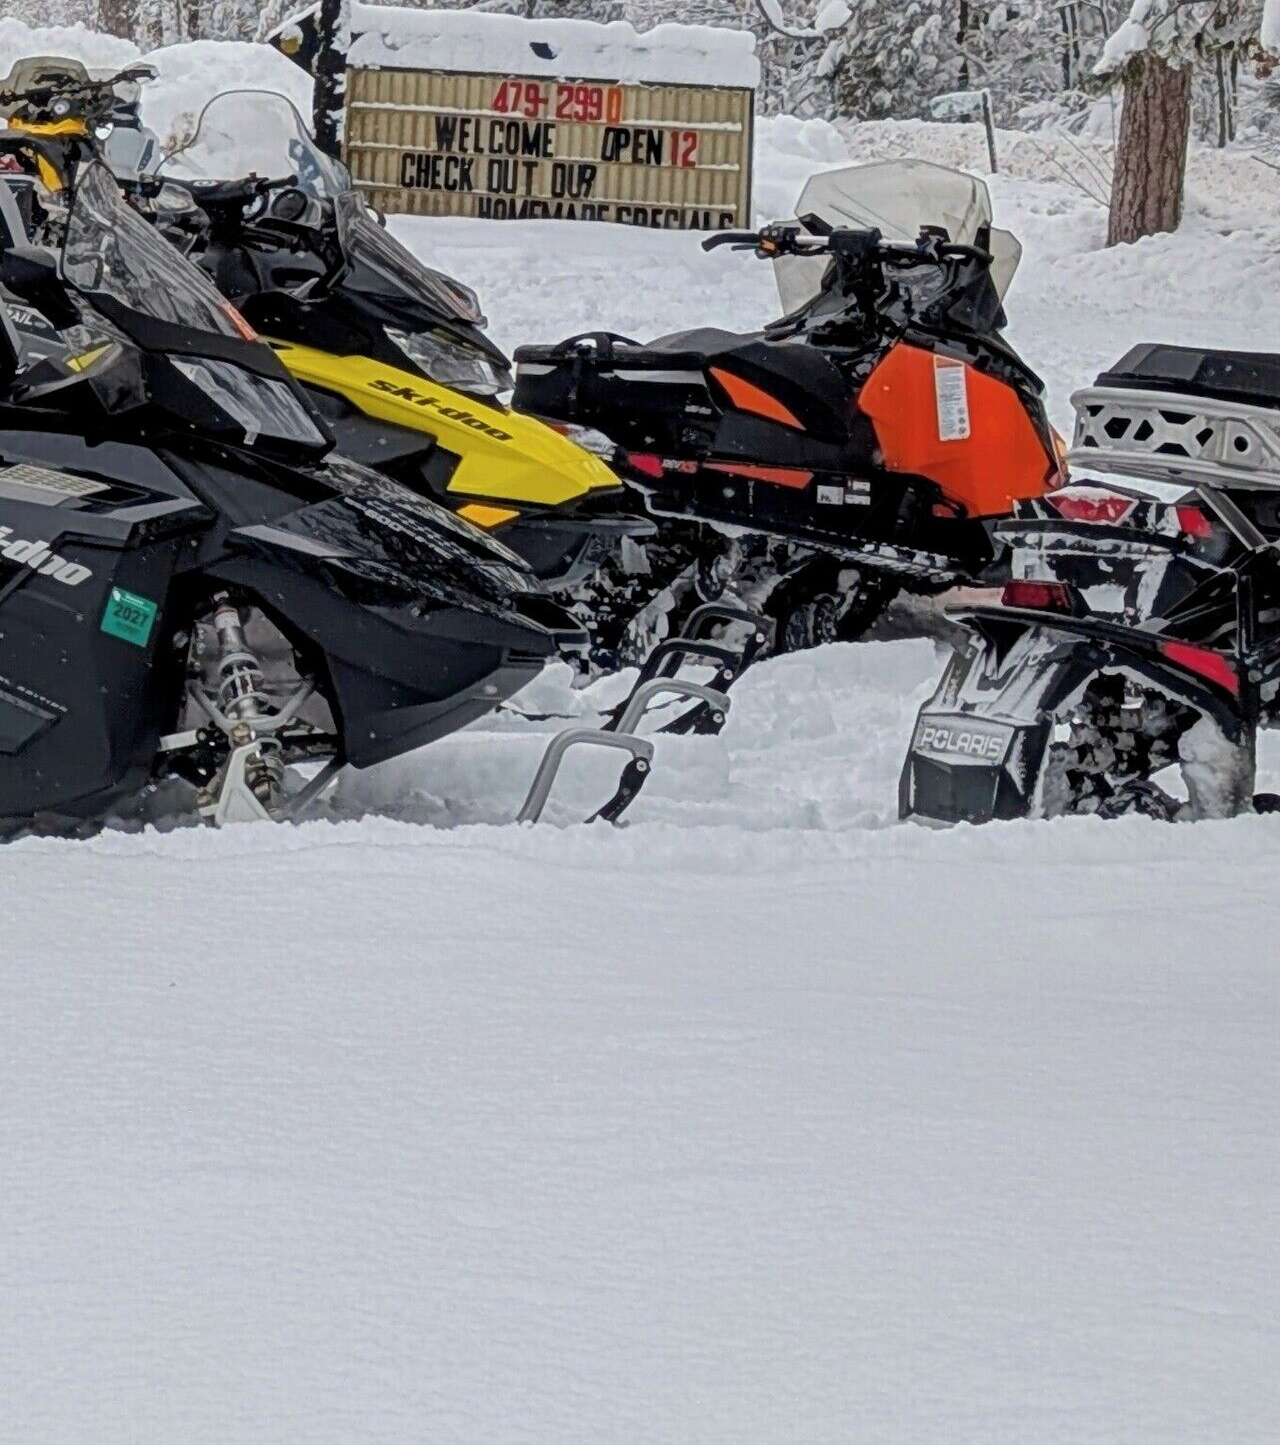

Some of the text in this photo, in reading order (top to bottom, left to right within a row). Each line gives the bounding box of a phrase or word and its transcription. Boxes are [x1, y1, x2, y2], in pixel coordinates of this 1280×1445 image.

[435, 116, 698, 168] WELCOME OPEN 12
[400, 152, 597, 199] CHECK OUT OUR
[367, 379, 514, 442] ski-doo
[921, 727, 1004, 761] POLARIS
